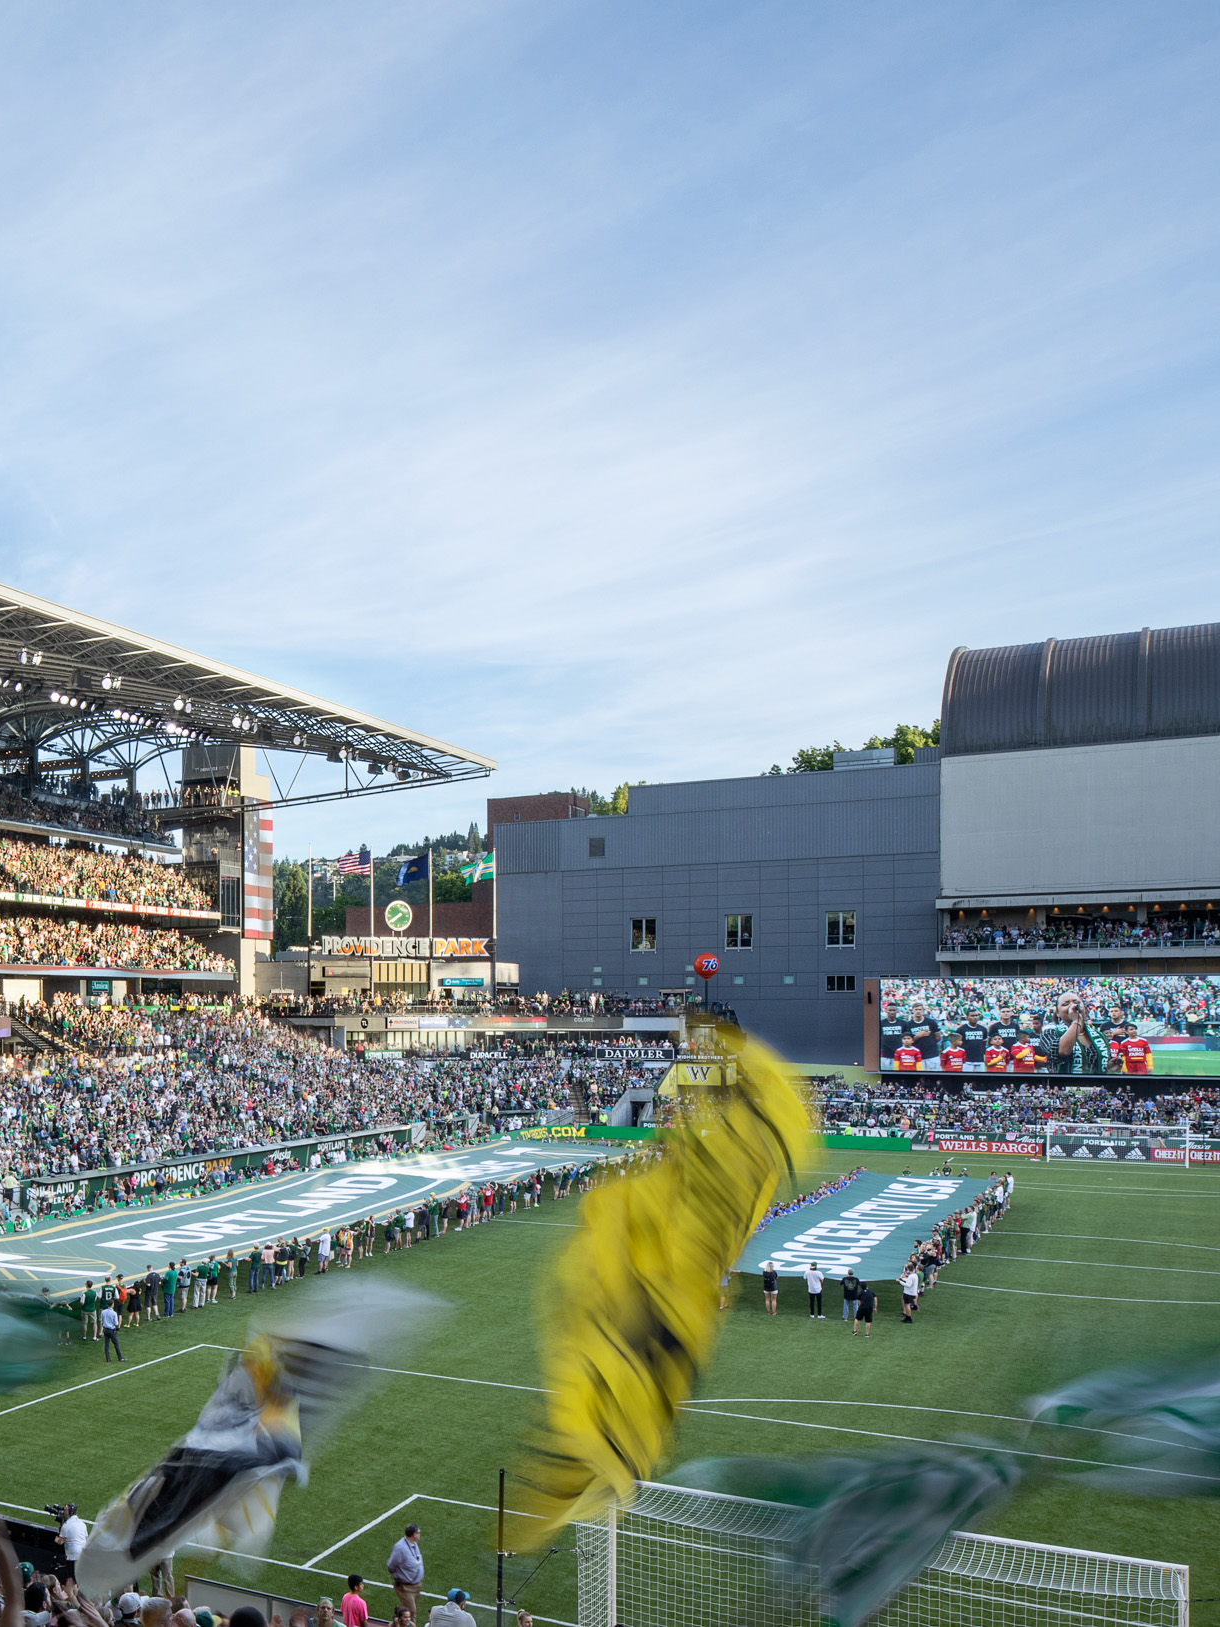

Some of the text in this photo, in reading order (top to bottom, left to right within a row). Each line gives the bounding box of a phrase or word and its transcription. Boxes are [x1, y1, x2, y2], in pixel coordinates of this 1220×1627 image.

[321, 935, 490, 957] PROVIDENCE PARK
[702, 957, 718, 971] 76
[604, 1050, 666, 1059] DAIMLER
[685, 1065, 713, 1083] W
[940, 1140, 1039, 1154] WELLS FARGO
[1016, 1134, 1045, 1144] Alaska
[95, 1176, 398, 1252] PORTLAND
[757, 1176, 964, 1274] SOCCER CITY USA
